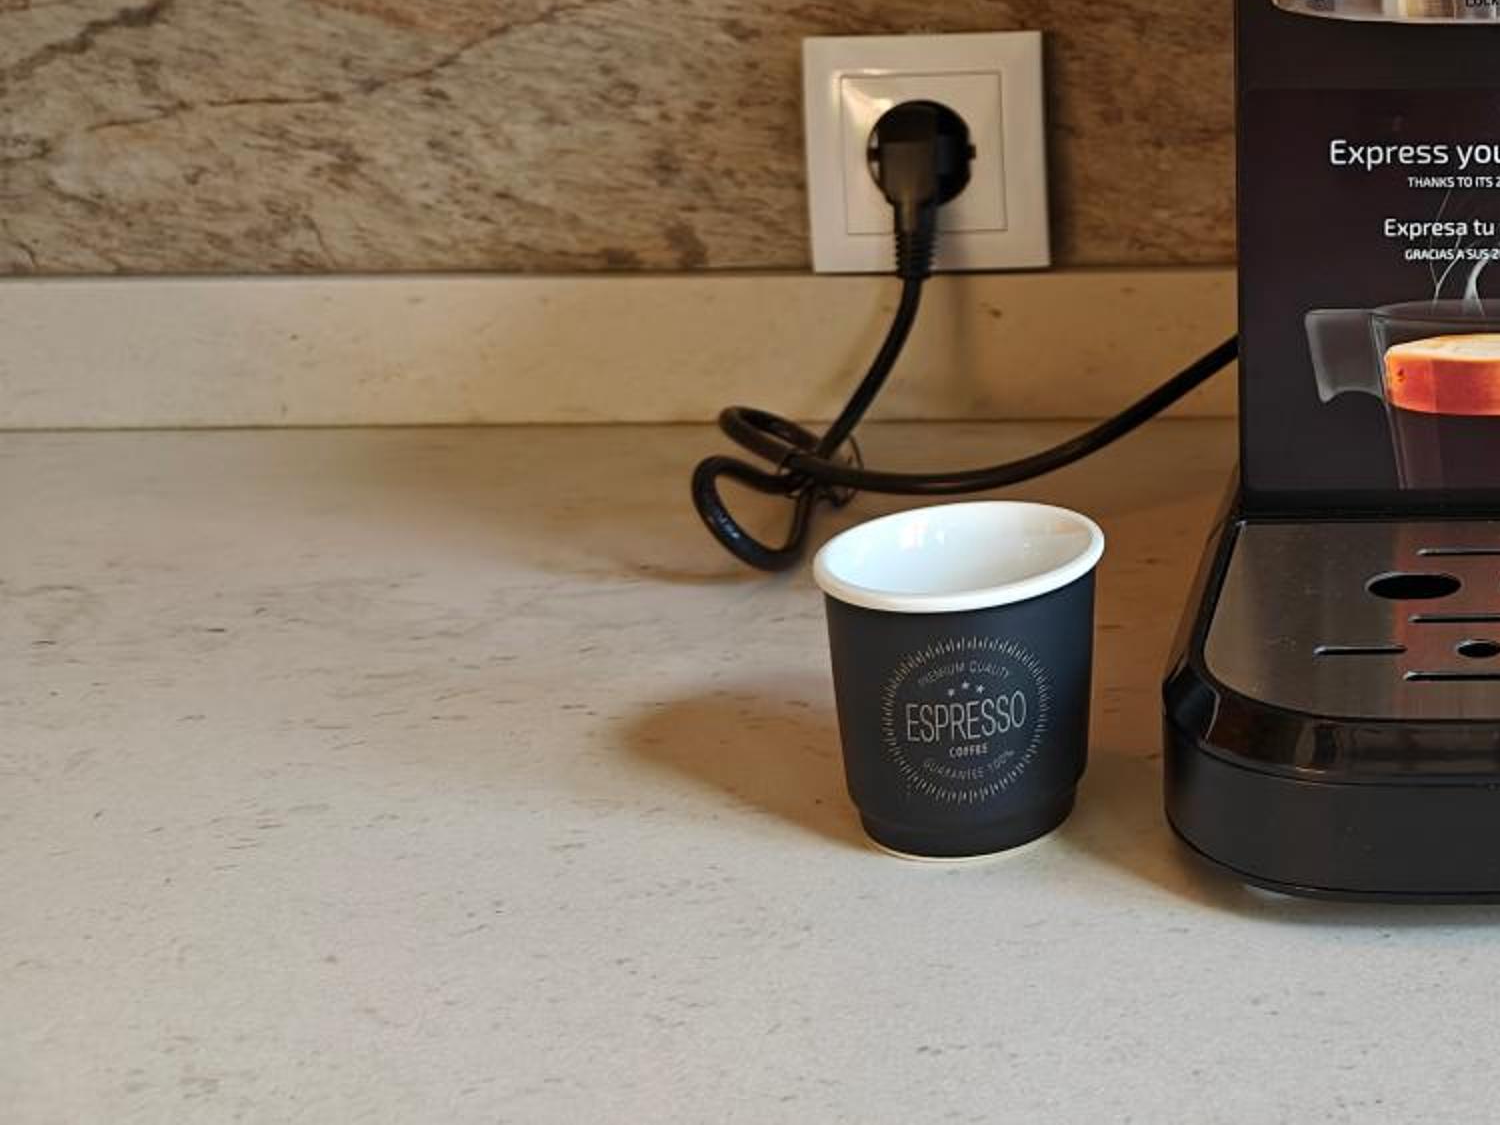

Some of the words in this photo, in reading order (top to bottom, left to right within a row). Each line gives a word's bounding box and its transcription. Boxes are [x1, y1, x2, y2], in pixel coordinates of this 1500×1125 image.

[1330, 140, 1449, 170] Express
[1408, 176, 1455, 188] THANKS
[1456, 176, 1473, 188] TO
[1475, 176, 1494, 188] ITS
[1385, 218, 1468, 241] Expresa
[1473, 219, 1495, 236] tu
[1404, 248, 1455, 260] GRACIAS
[1457, 248, 1465, 260] A
[1466, 248, 1489, 260] SUS
[905, 690, 1027, 743] ESPRESSO
[949, 743, 988, 758] COFFEE
